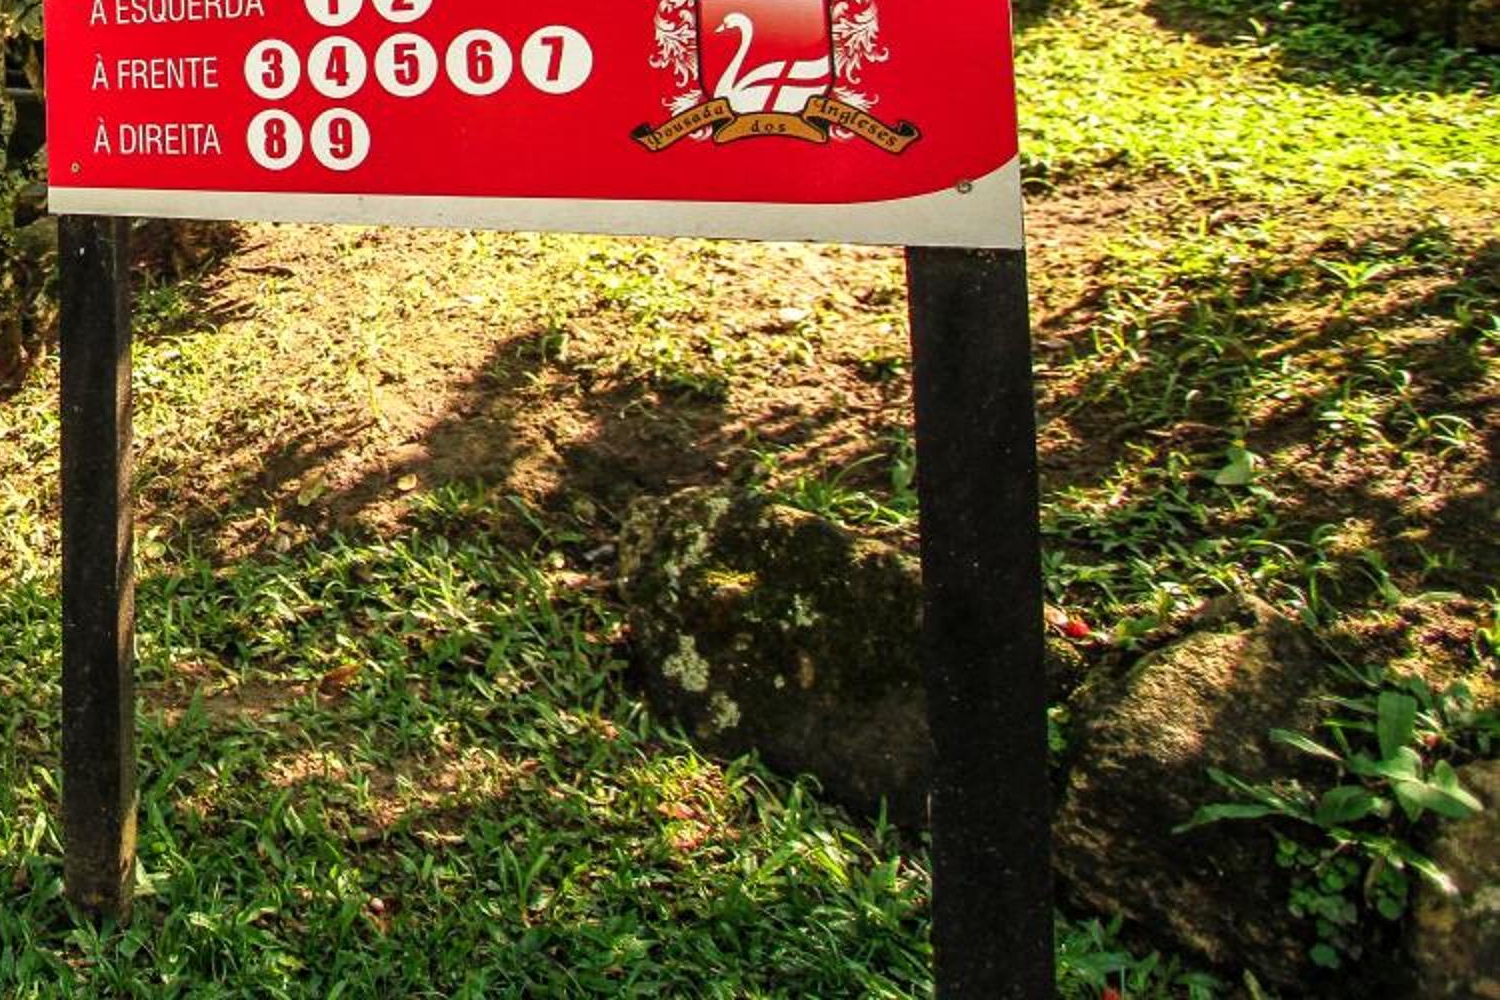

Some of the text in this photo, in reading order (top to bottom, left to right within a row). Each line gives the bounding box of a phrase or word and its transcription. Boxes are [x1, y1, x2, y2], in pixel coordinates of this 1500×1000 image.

[92, 36, 565, 91] À FRENTE 3 4 5 6 7
[94, 116, 353, 160] À DIREITA 8 9
[750, 119, 787, 134] dos
[812, 98, 898, 147] Ingleses
